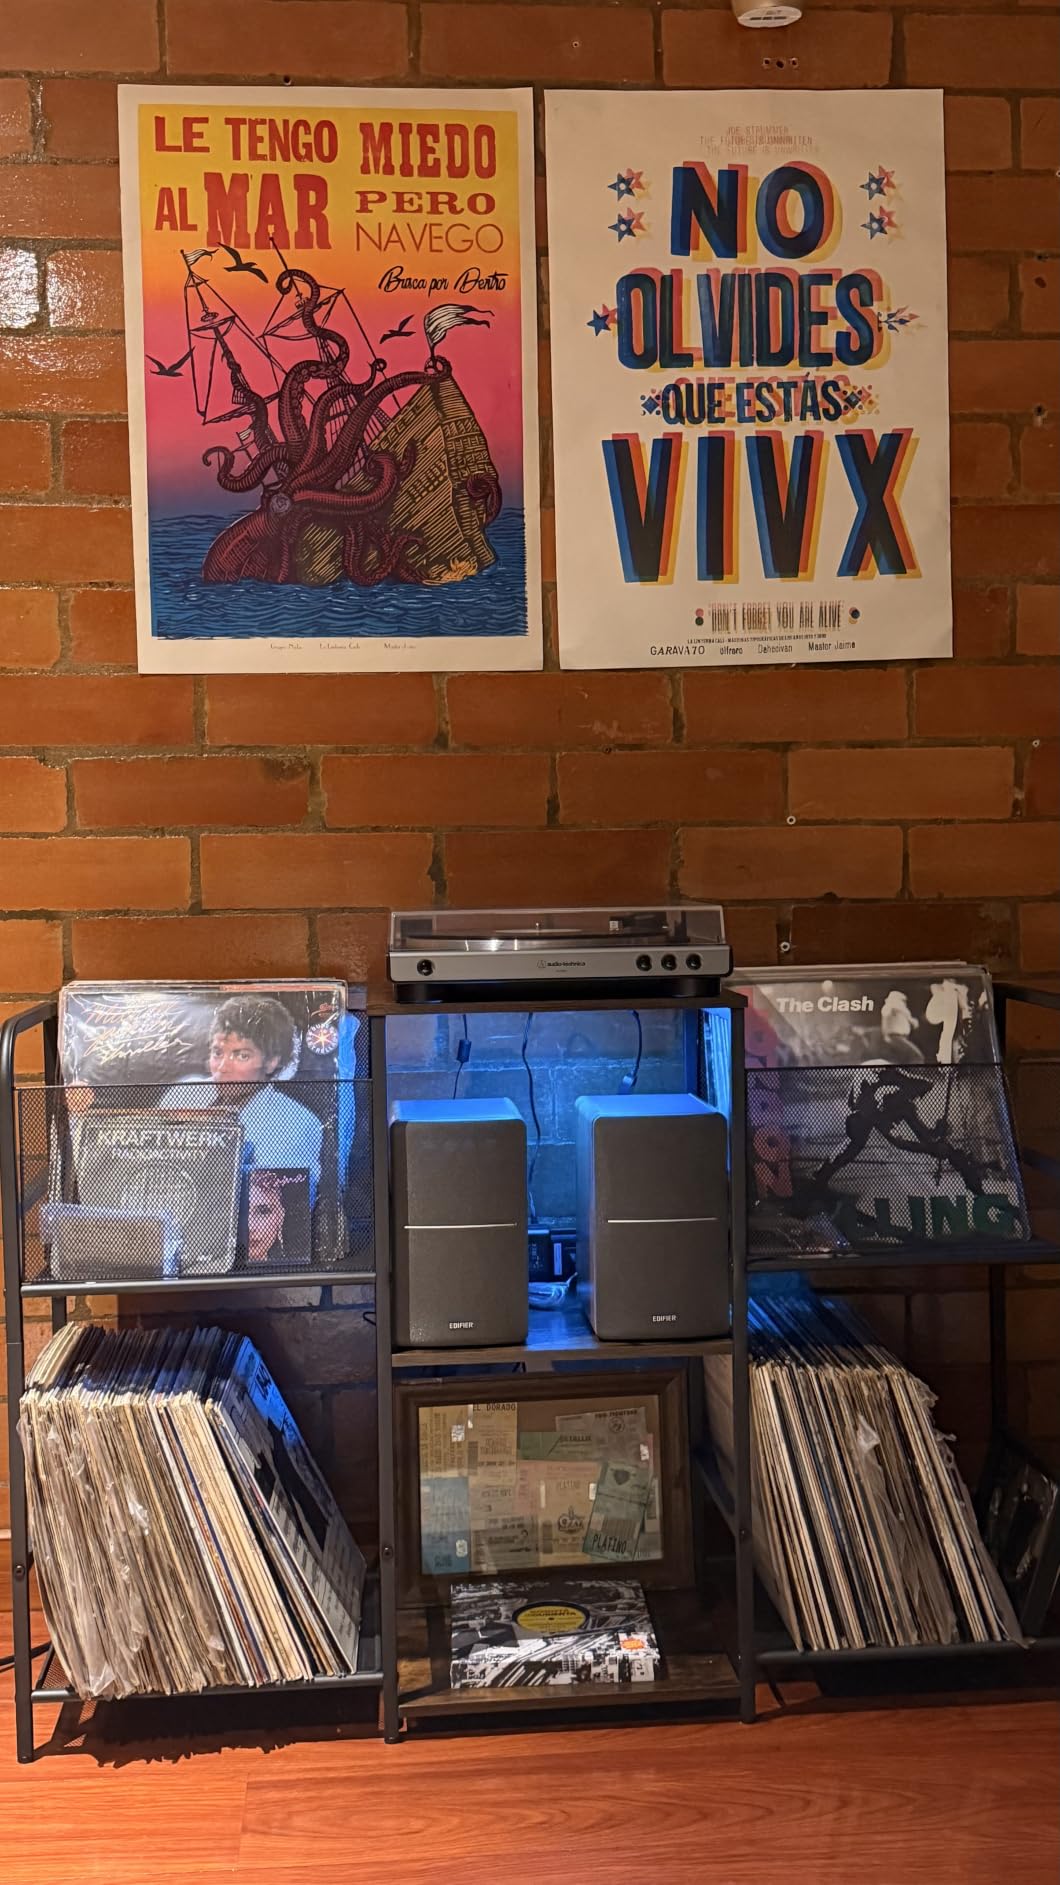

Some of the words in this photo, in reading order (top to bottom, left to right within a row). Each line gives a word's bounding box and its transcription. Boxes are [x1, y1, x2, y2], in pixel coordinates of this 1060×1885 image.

[154, 116, 210, 153] LE
[225, 117, 338, 163] TENGO
[359, 122, 497, 179] MIEDO
[154, 186, 198, 232] AL
[204, 172, 332, 251] MAR
[355, 190, 497, 215] PERO
[671, 161, 839, 262] NO
[355, 223, 504, 254] NAVEGO
[427, 277, 449, 298] por
[454, 266, 509, 294] Dentro
[616, 267, 886, 370] OLVIDES
[661, 378, 729, 426] QUE
[735, 373, 847, 424] ESTÁS
[602, 429, 918, 584] VIVX
[742, 602, 772, 633] FORGET
[777, 601, 794, 630] YOU
[799, 600, 814, 629] ARE
[776, 997, 815, 1013] The
[817, 996, 874, 1013] Clash
[97, 1130, 227, 1147] KRAFTWERK
[449, 1321, 474, 1330] EDIFIER
[652, 1314, 677, 1323] EDIFIER
